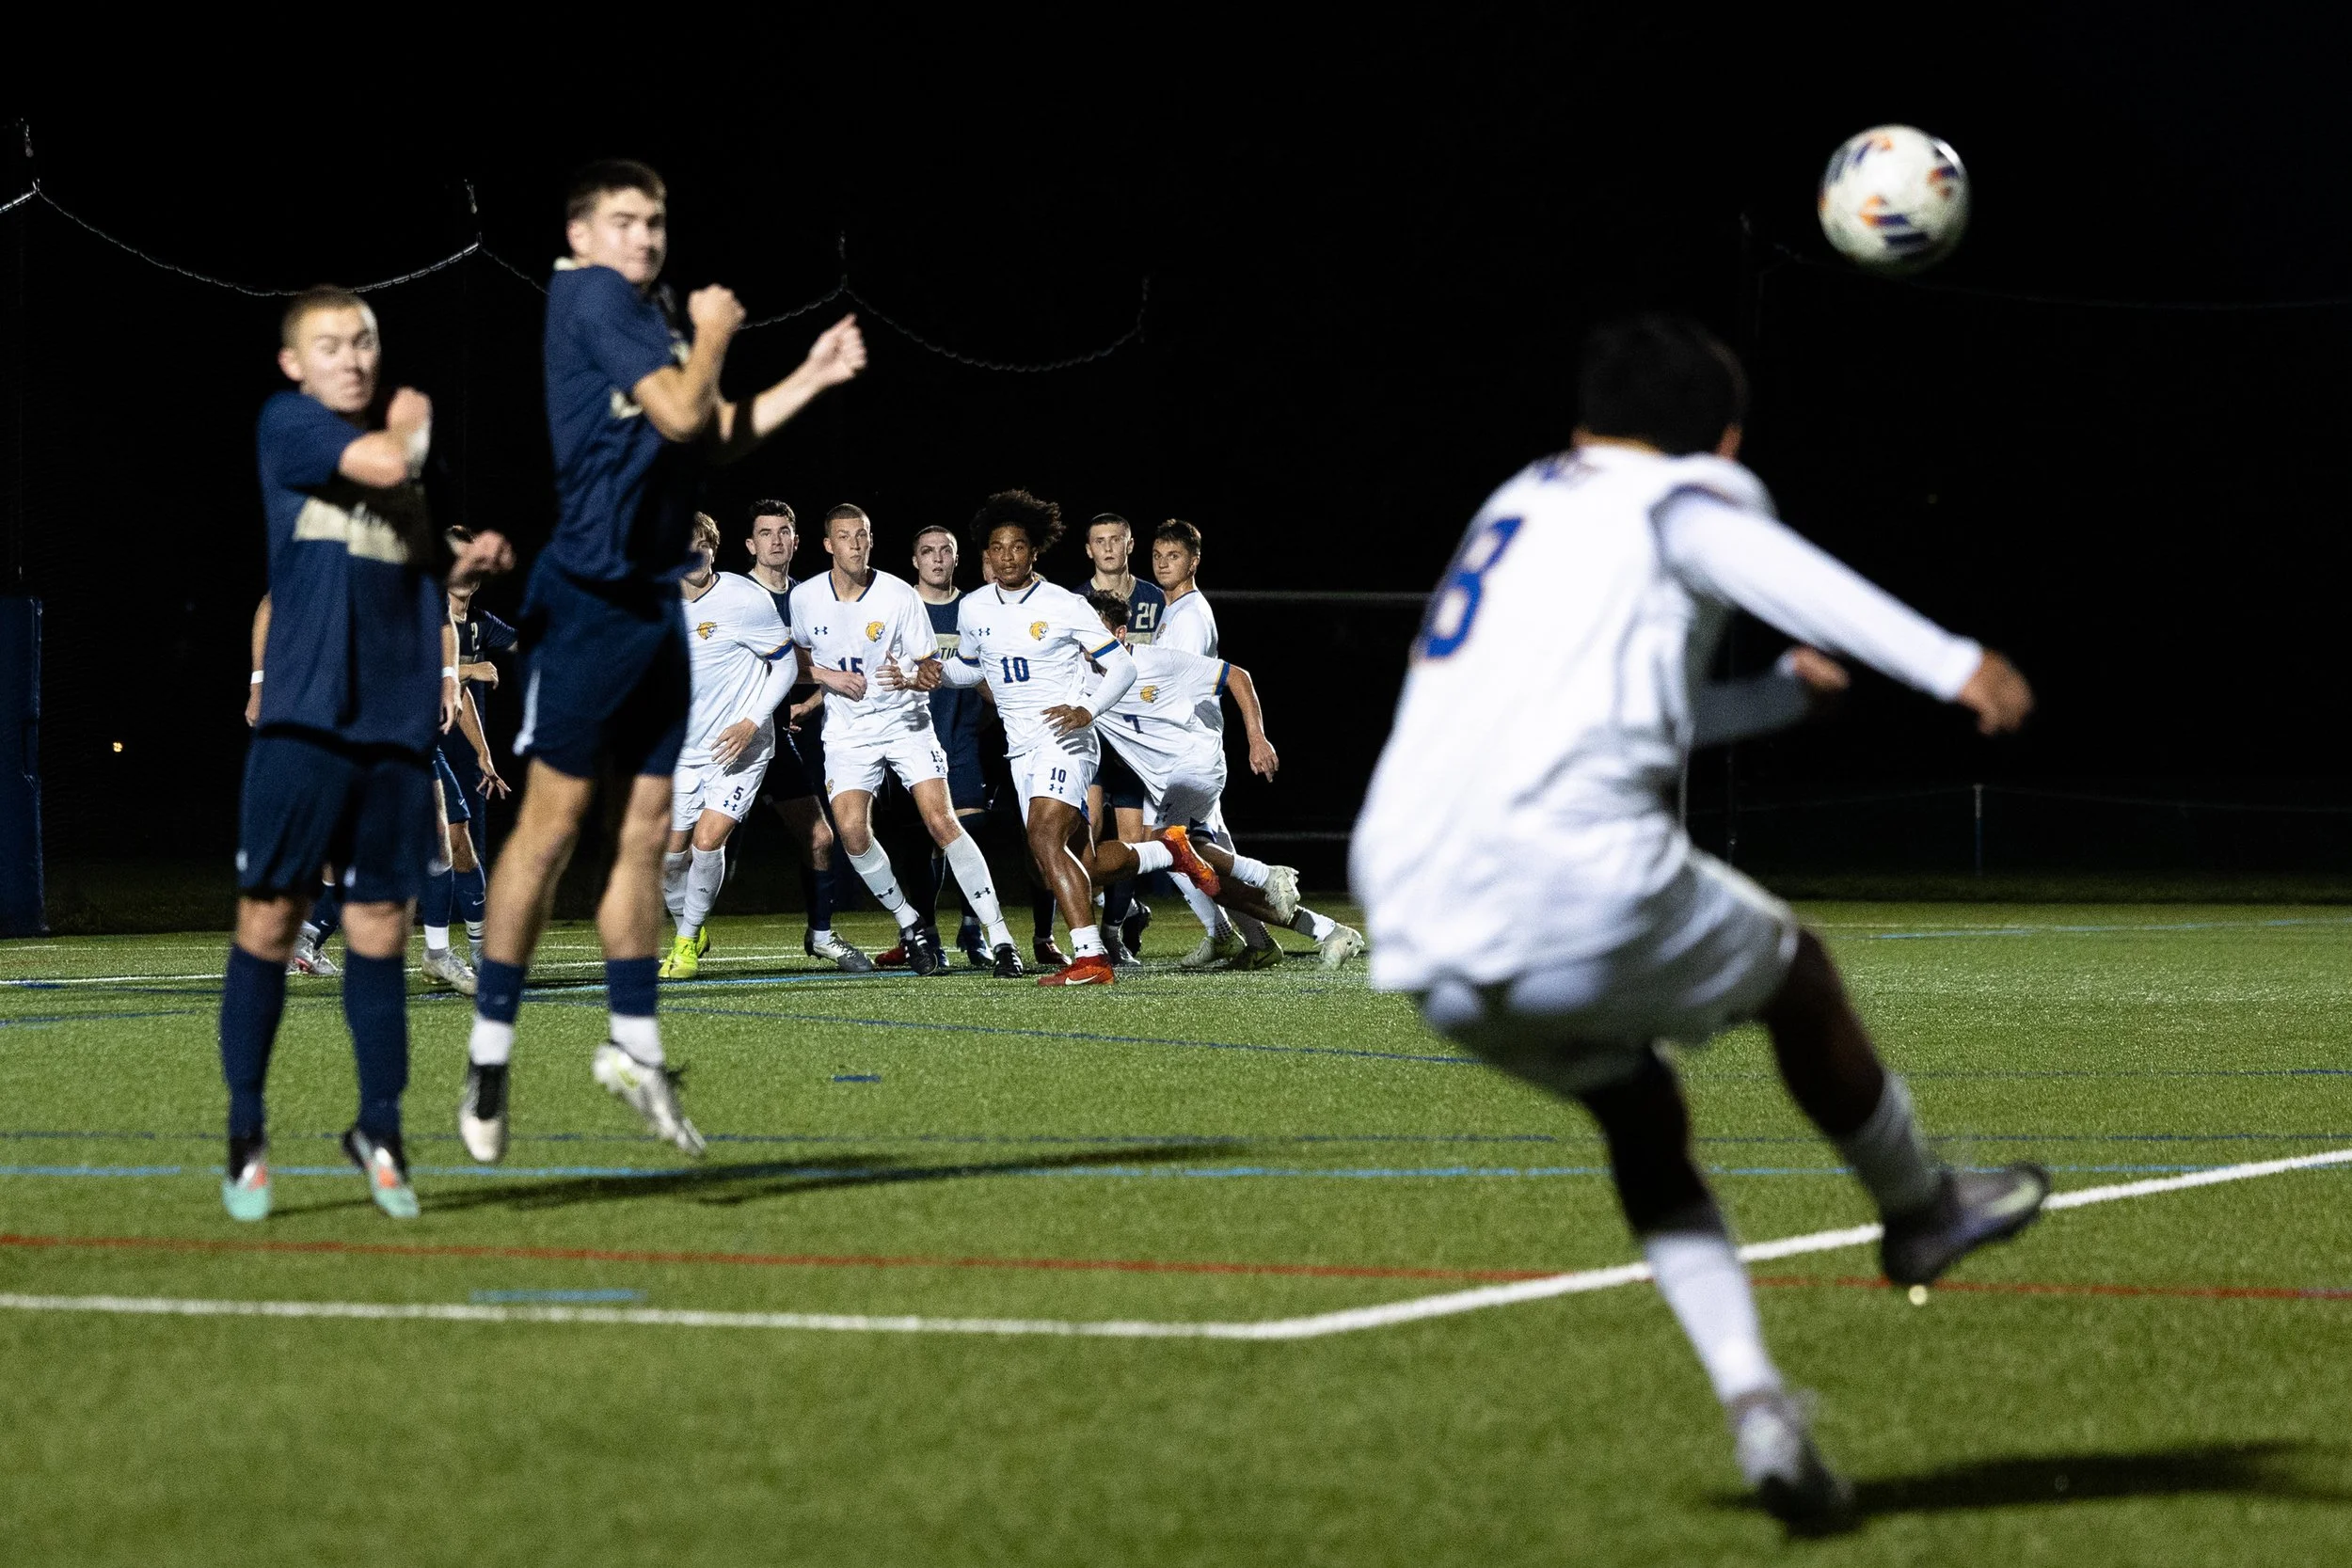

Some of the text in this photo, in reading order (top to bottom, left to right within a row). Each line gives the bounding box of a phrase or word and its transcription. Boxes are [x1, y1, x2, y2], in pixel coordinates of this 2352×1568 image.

[1414, 515, 1523, 660] 8
[1135, 602, 1157, 629] 21
[837, 657, 863, 675] 15
[1000, 657, 1030, 683] 10
[1050, 767, 1067, 784] 10
[733, 785, 744, 800] 5
